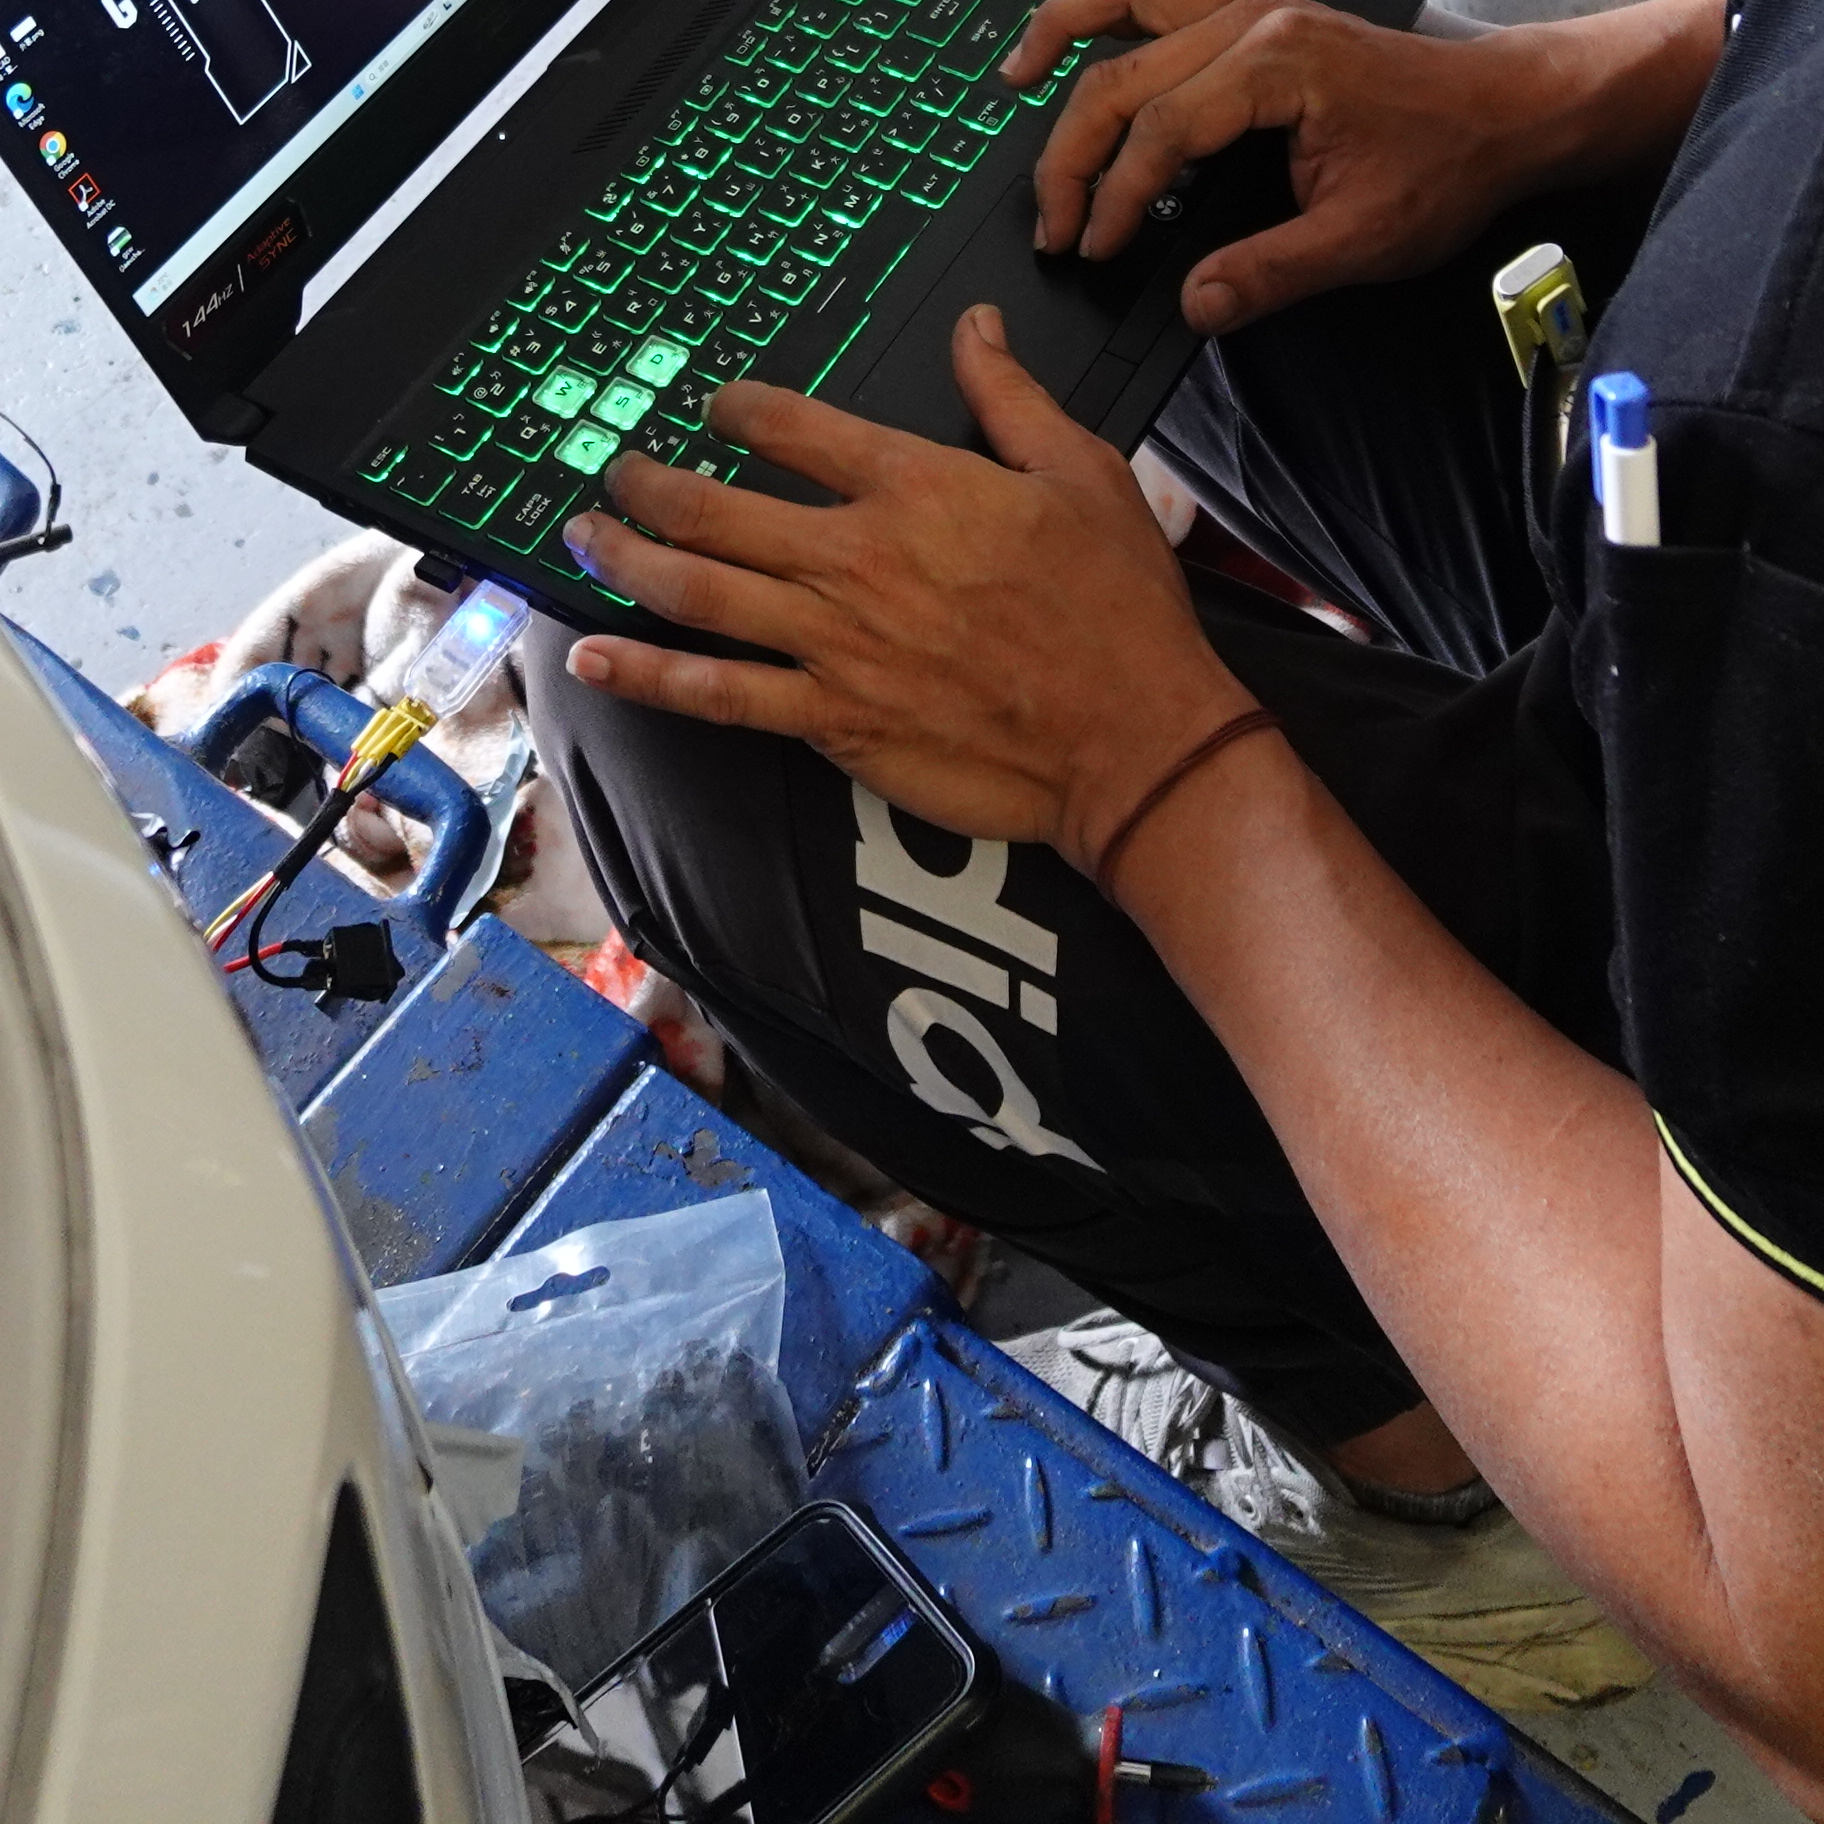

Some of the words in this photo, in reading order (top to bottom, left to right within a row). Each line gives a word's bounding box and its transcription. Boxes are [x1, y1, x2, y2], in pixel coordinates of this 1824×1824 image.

[970, 18, 991, 42] SHIFT
[816, 77, 828, 89] P
[17, 102, 46, 128] Microsoft
[976, 99, 998, 122] CTRL
[725, 112, 740, 123] 9
[841, 124, 856, 133] L
[952, 139, 966, 153] FN
[694, 147, 709, 159] 8
[53, 152, 75, 172] Google
[810, 158, 825, 170] K
[57, 158, 80, 180] Chrome
[922, 173, 938, 192] ALT
[661, 184, 674, 195] 7
[725, 184, 741, 197] U
[785, 194, 796, 207] J
[843, 194, 860, 208] M
[86, 198, 106, 218] Adobe
[629, 222, 645, 234] 6
[692, 222, 706, 232] Y
[748, 232, 764, 245] H
[813, 232, 829, 245] N
[595, 260, 611, 273] 5
[659, 260, 673, 271] T
[716, 271, 732, 284] G
[781, 272, 797, 285] B
[565, 299, 577, 312] 4
[626, 300, 642, 314] R
[683, 311, 694, 324] F
[748, 311, 762, 323] V
[525, 340, 541, 354] 3
[591, 341, 607, 355] E
[649, 353, 664, 365] D
[716, 353, 732, 366] C
[489, 382, 505, 396] 2
[554, 380, 573, 397] W
[614, 396, 630, 408] S
[681, 395, 698, 409] X
[453, 427, 466, 435] 1
[519, 426, 538, 440] Q
[581, 440, 595, 452] A
[646, 438, 663, 452] Z
[370, 446, 392, 468] ESC
[460, 473, 483, 494] TAB
[515, 493, 542, 522] CAPS
[524, 497, 552, 526] LOCK
